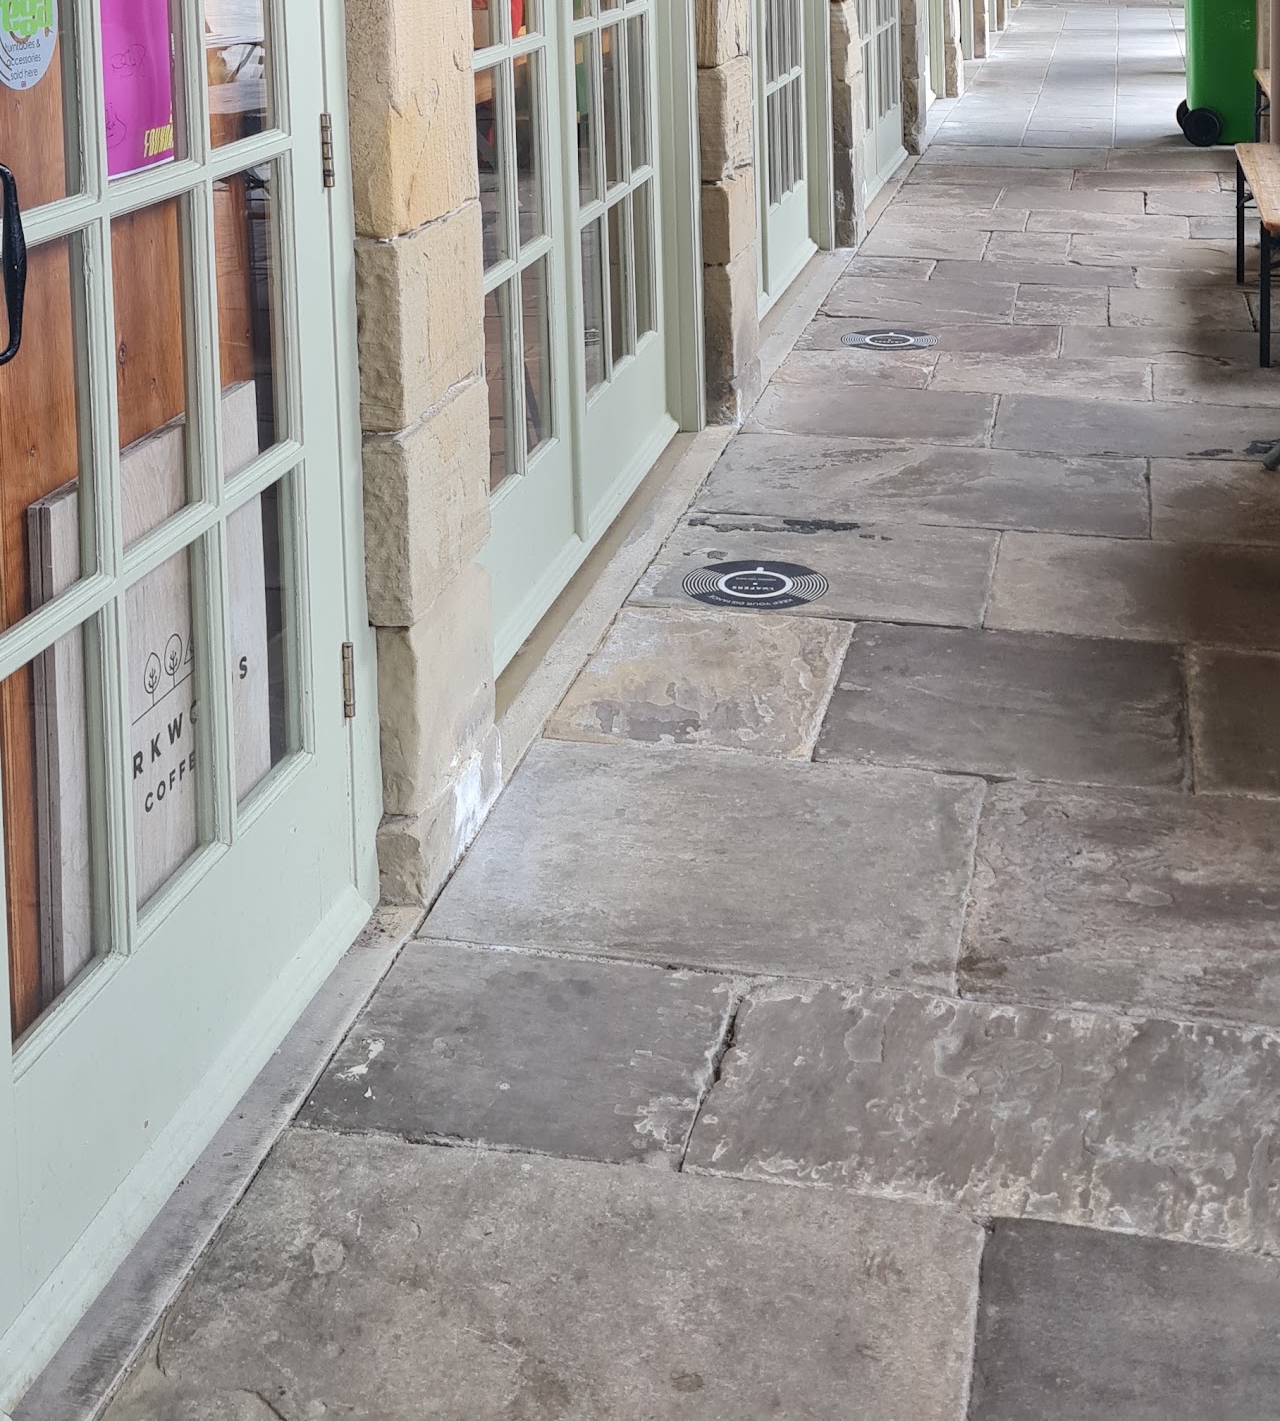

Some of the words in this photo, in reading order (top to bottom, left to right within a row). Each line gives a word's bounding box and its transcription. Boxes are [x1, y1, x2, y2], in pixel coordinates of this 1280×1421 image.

[5, 40, 35, 52] turntables
[36, 38, 41, 48] &
[7, 53, 41, 66] accessories
[11, 69, 23, 80] sold
[24, 68, 38, 78] here
[708, 594, 745, 605] DISTANCE
[772, 597, 793, 605] KEEP
